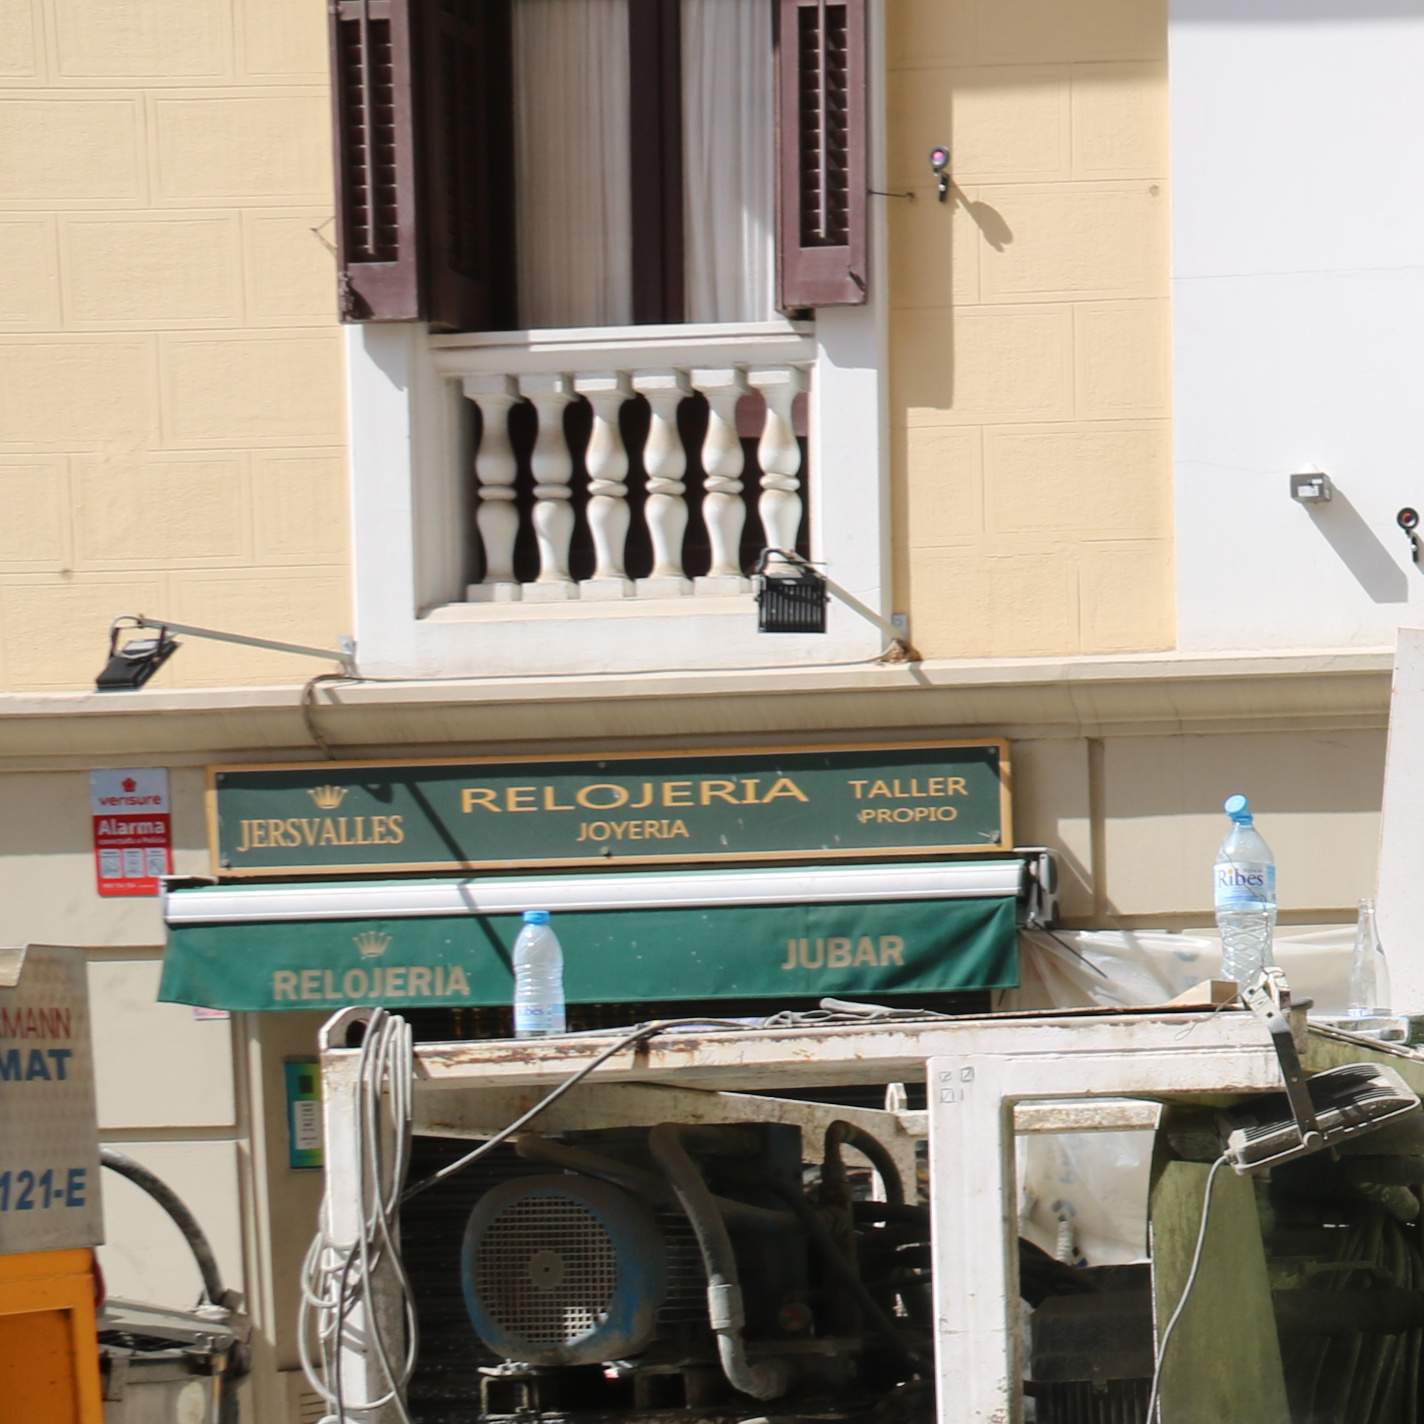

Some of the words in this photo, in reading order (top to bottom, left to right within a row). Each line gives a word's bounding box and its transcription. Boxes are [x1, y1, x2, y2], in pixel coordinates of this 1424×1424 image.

[460, 775, 810, 816] RELOJERIA
[848, 776, 968, 801] TALLER
[97, 818, 166, 836] Alarma
[237, 814, 405, 853] JERSVALLES
[576, 819, 690, 842] JOYERIA
[861, 803, 958, 825] PROPIO
[1217, 868, 1264, 889] Ribes
[271, 966, 471, 1002] RELOJERIA
[779, 932, 906, 971] JUBAR
[0, 1007, 73, 1040] MANN
